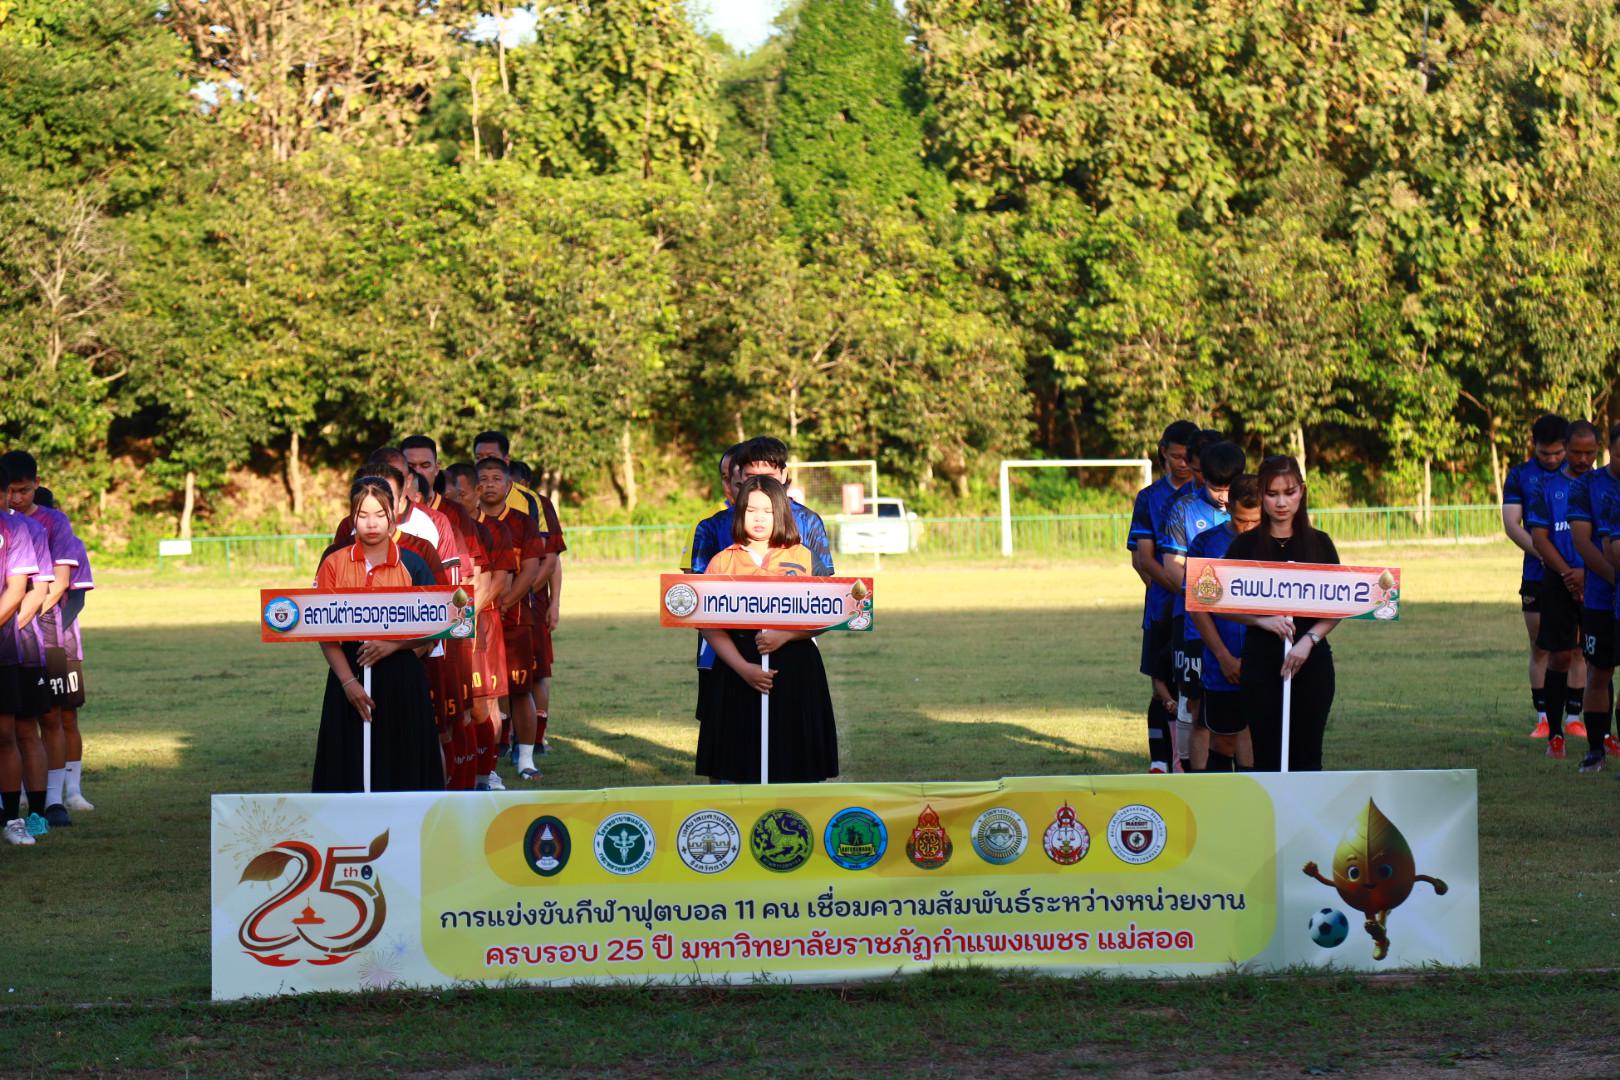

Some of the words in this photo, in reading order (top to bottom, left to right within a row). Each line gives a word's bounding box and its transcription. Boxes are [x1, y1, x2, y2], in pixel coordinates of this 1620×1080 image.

[703, 590, 843, 615] เทศบาลนครแม่สอด
[1230, 577, 1315, 600] สพป.ตาก
[1319, 584, 1351, 601] เขต
[1353, 581, 1371, 603] 2
[304, 599, 447, 629] สถานีตำรวจภูธรแม่สอด
[1184, 657, 1201, 682] 24
[440, 898, 727, 931] การแข่งขันกีฬาฟุตบอล
[735, 899, 755, 920] 11
[762, 901, 800, 920] คน
[807, 886, 1246, 919] เชื่อมความสัมพันธ์ระหว่างหน่วยงาน
[486, 943, 599, 966] ครบรอบ
[606, 938, 645, 962] 25
[652, 933, 673, 961] ปี
[681, 928, 1090, 961] มหาวิทยาลัยราชภัฏกำแพงเพชร
[1097, 923, 1195, 951] แม่สอด
